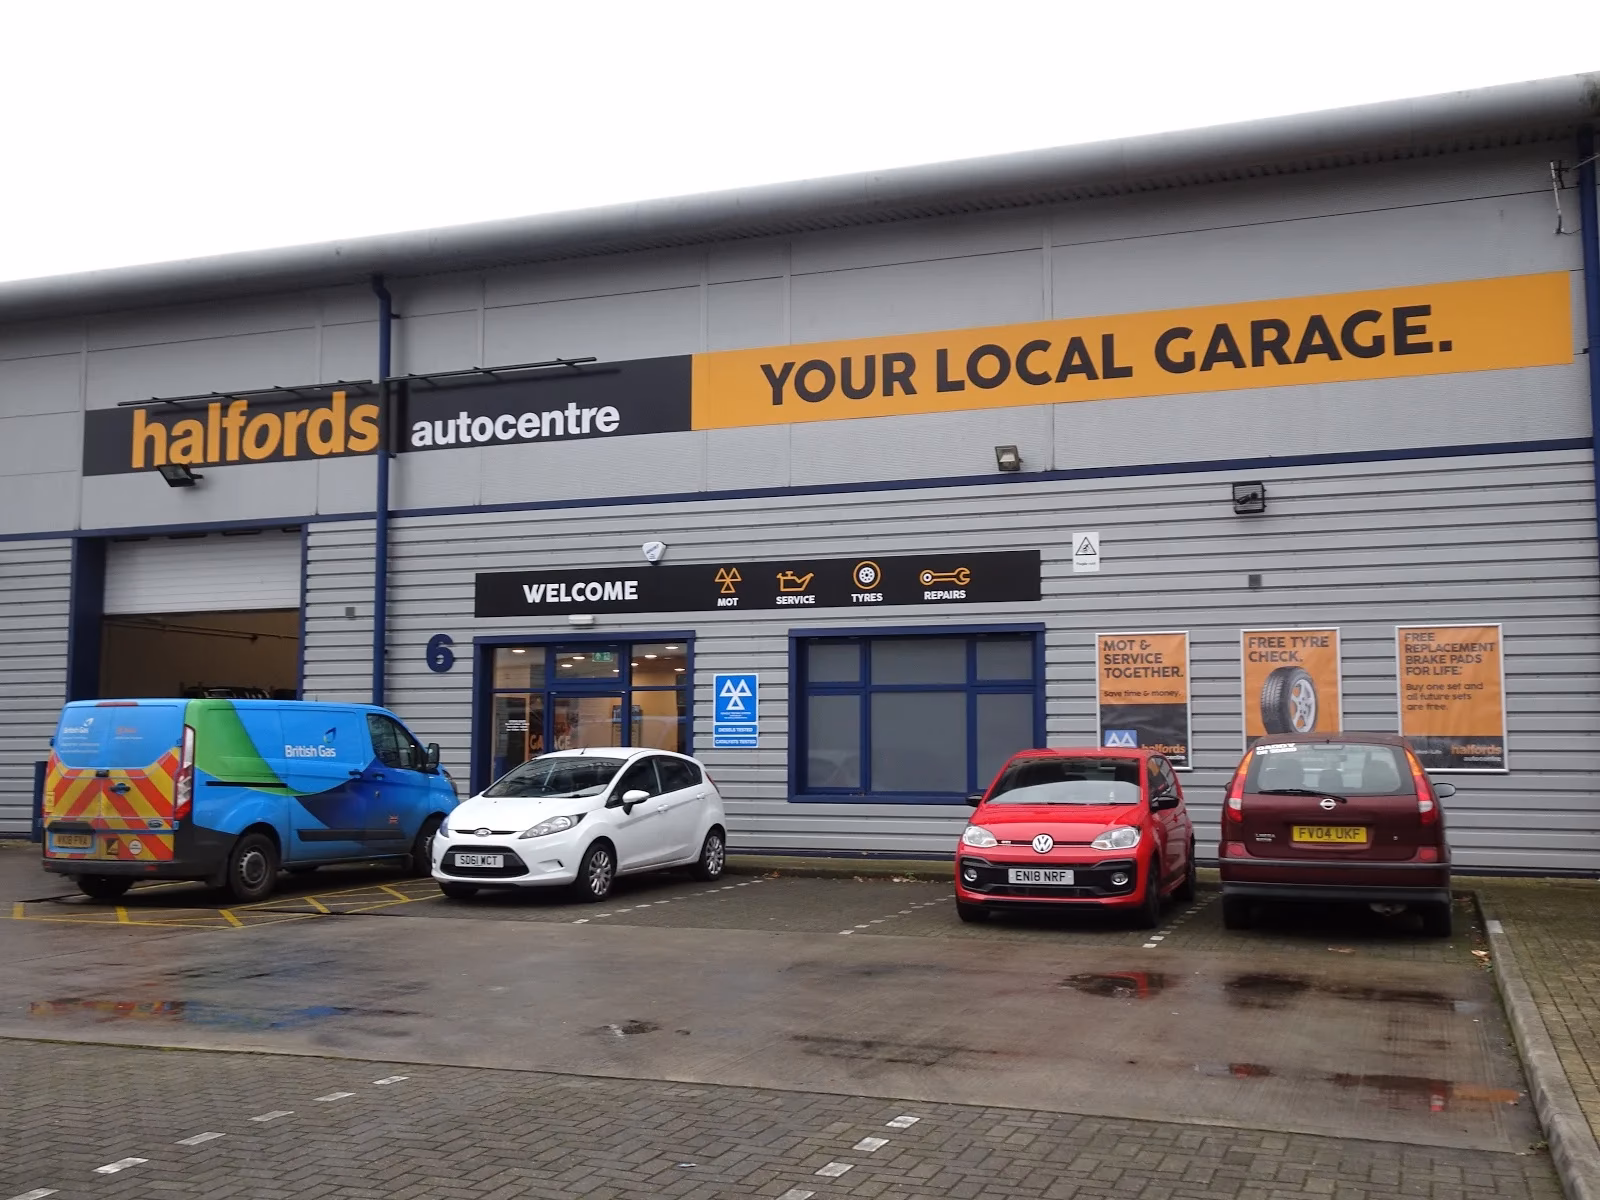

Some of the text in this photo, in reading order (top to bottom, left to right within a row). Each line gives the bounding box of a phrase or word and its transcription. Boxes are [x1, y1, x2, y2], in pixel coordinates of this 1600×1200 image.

[760, 305, 1452, 405] YOUR LOCAL GARAGE.
[132, 391, 620, 468] halfords autocentre
[523, 581, 638, 603] WELCOME
[924, 590, 966, 600] REPAIRS
[717, 598, 739, 607] MOT
[776, 595, 816, 605] SERVICE
[851, 593, 883, 602] TYRES
[1248, 636, 1329, 648] FREE TYRE
[1405, 633, 1435, 641] FREE
[1104, 639, 1151, 651] MOT &
[1405, 643, 1495, 653] REPLACEMENT
[427, 634, 454, 673] 6
[1248, 651, 1304, 662] CHECK.
[1104, 653, 1163, 665] SERVICE
[1406, 654, 1483, 664] BRAKE PADS
[1104, 666, 1184, 678] TOGETHER.
[1406, 667, 1431, 675] FOR
[1406, 684, 1424, 692] Buy
[1464, 682, 1484, 690] and
[1152, 690, 1182, 698] money.
[1426, 703, 1449, 711] free.
[285, 745, 336, 757] British Gas
[1451, 744, 1502, 754] halfords
[1298, 828, 1361, 839] FV04 UKF
[481, 856, 498, 865] WCT
[1016, 871, 1066, 882] EN18 NRF
